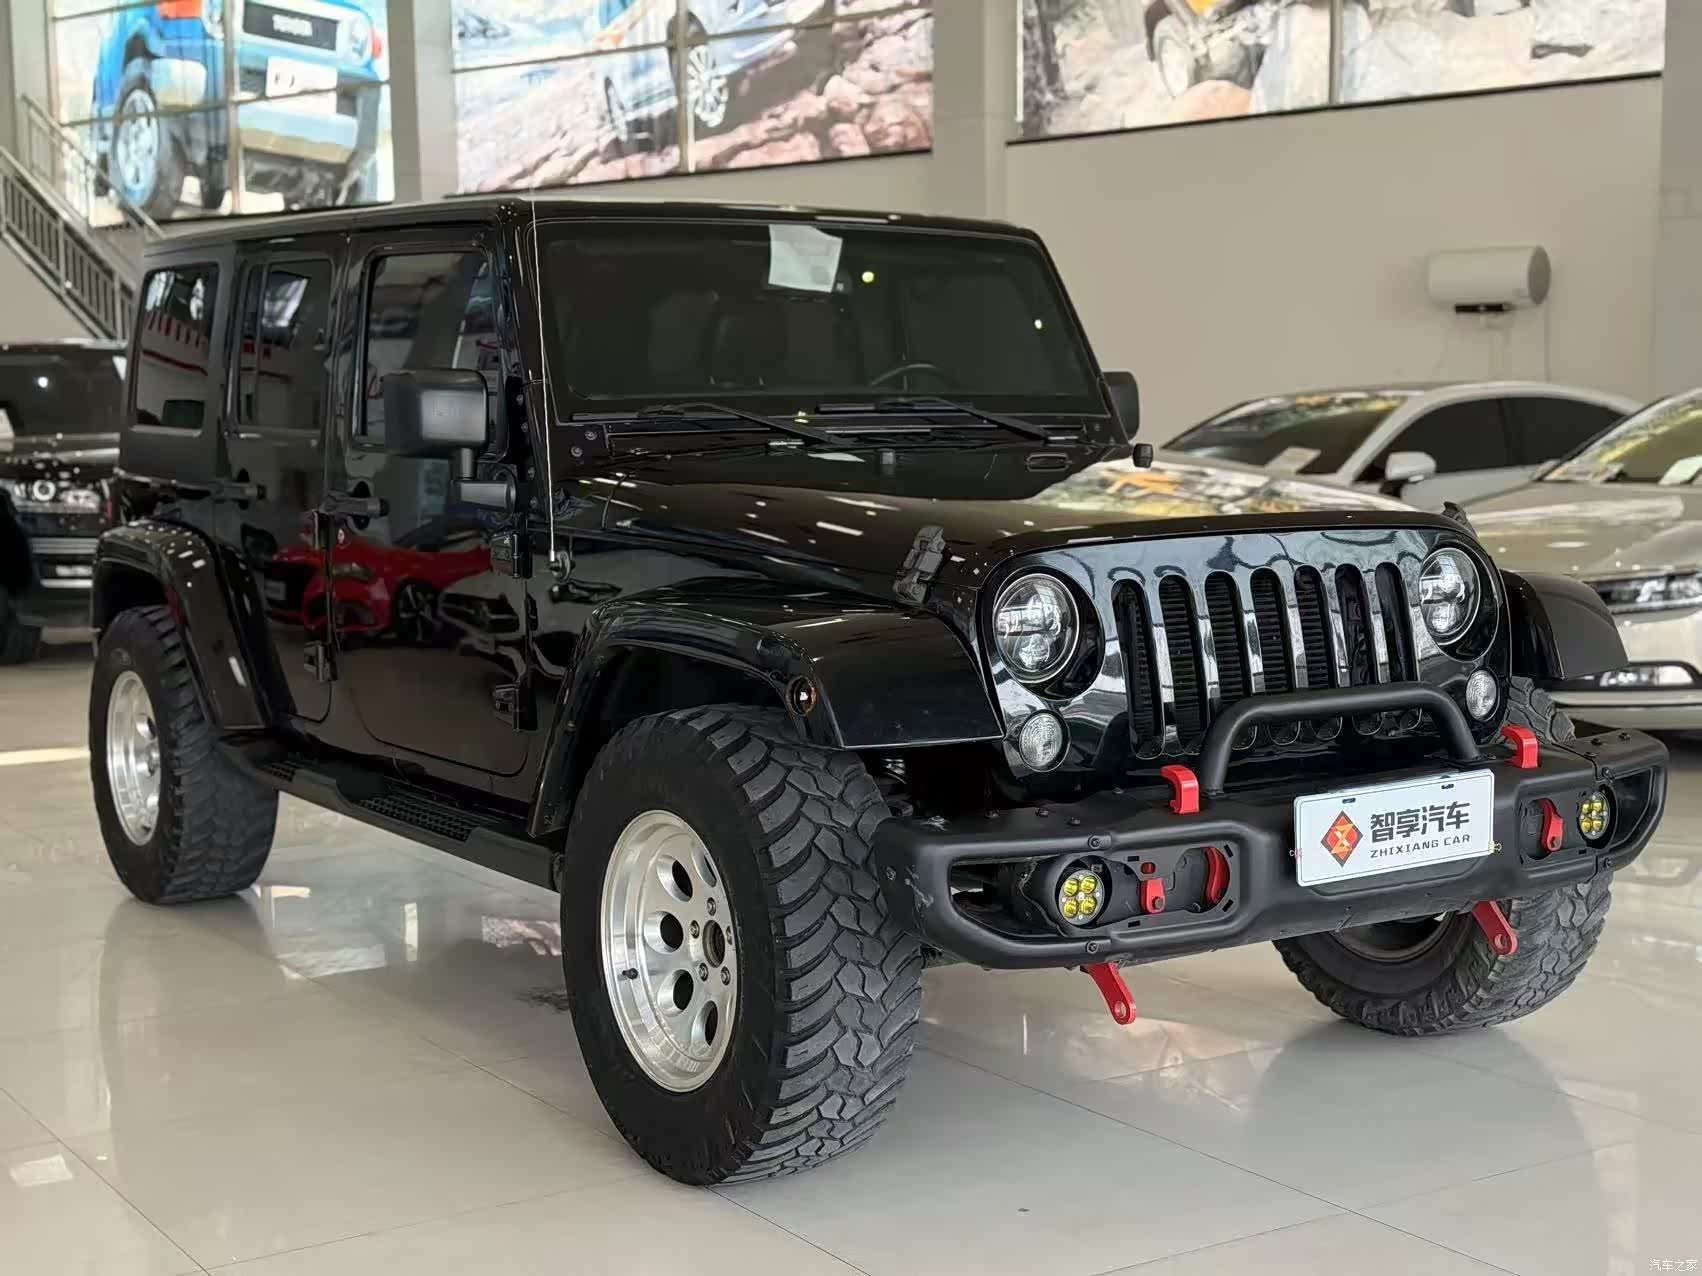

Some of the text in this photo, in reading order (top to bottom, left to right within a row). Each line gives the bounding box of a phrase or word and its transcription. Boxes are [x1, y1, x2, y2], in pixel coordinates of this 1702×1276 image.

[1370, 801, 1470, 843] 智享汽车
[1369, 834, 1470, 858] ZHIXIANG CAR
